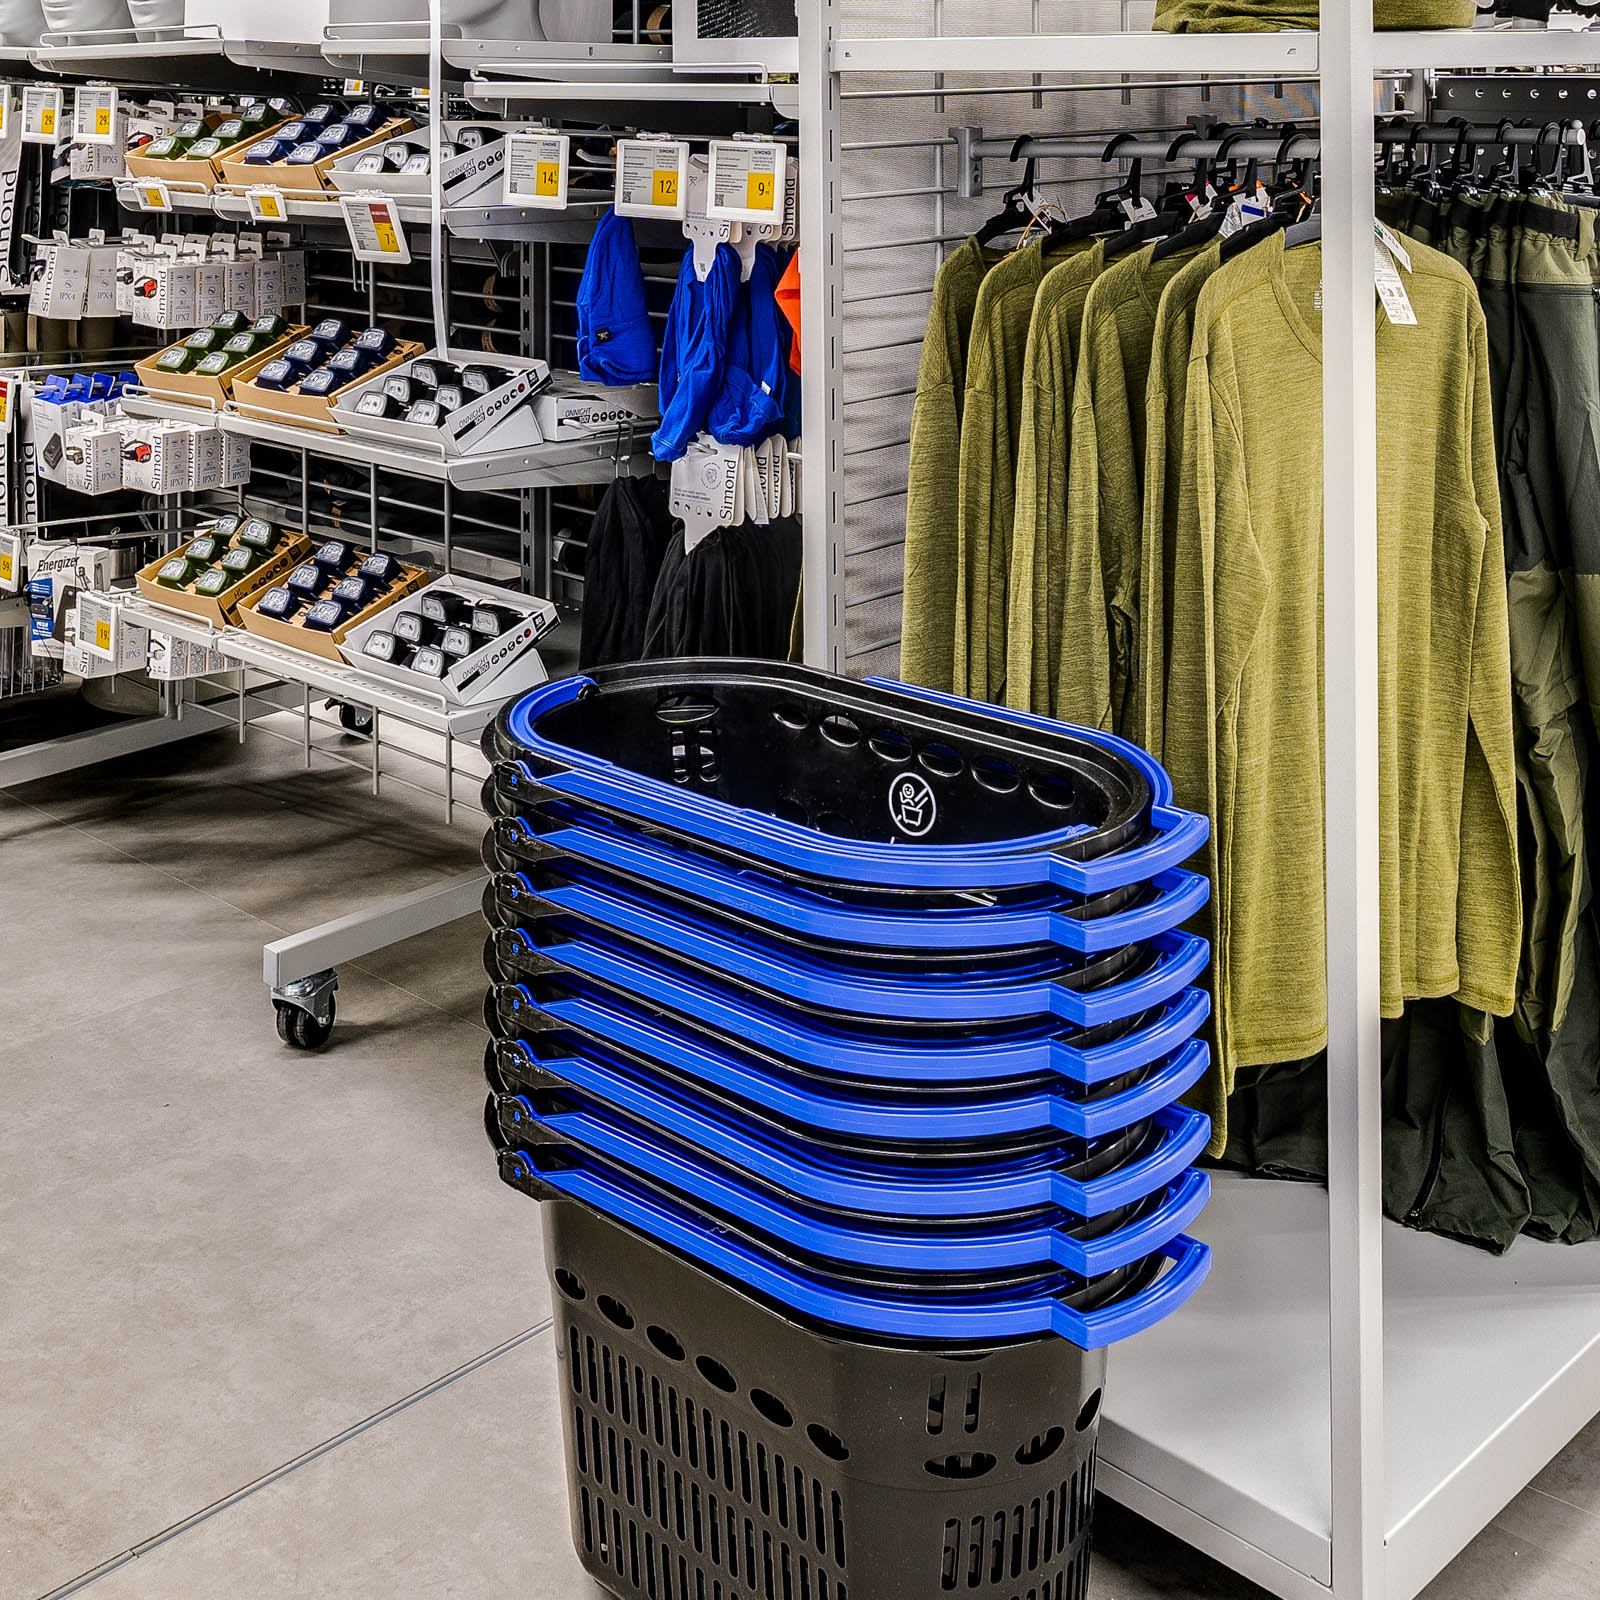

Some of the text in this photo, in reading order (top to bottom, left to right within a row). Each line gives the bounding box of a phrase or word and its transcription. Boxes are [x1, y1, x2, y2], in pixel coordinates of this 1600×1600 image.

[448, 158, 476, 179] ONNIGHT
[781, 177, 797, 237] Simond
[41, 251, 56, 312] Simond
[156, 270, 167, 325] Simond
[458, 406, 485, 429] ONNIGHT
[565, 406, 593, 418] ONNIGHT
[83, 439, 93, 491] Simond
[151, 436, 163, 491] Simond
[720, 459, 737, 520] Simond
[38, 556, 80, 572] Energizer
